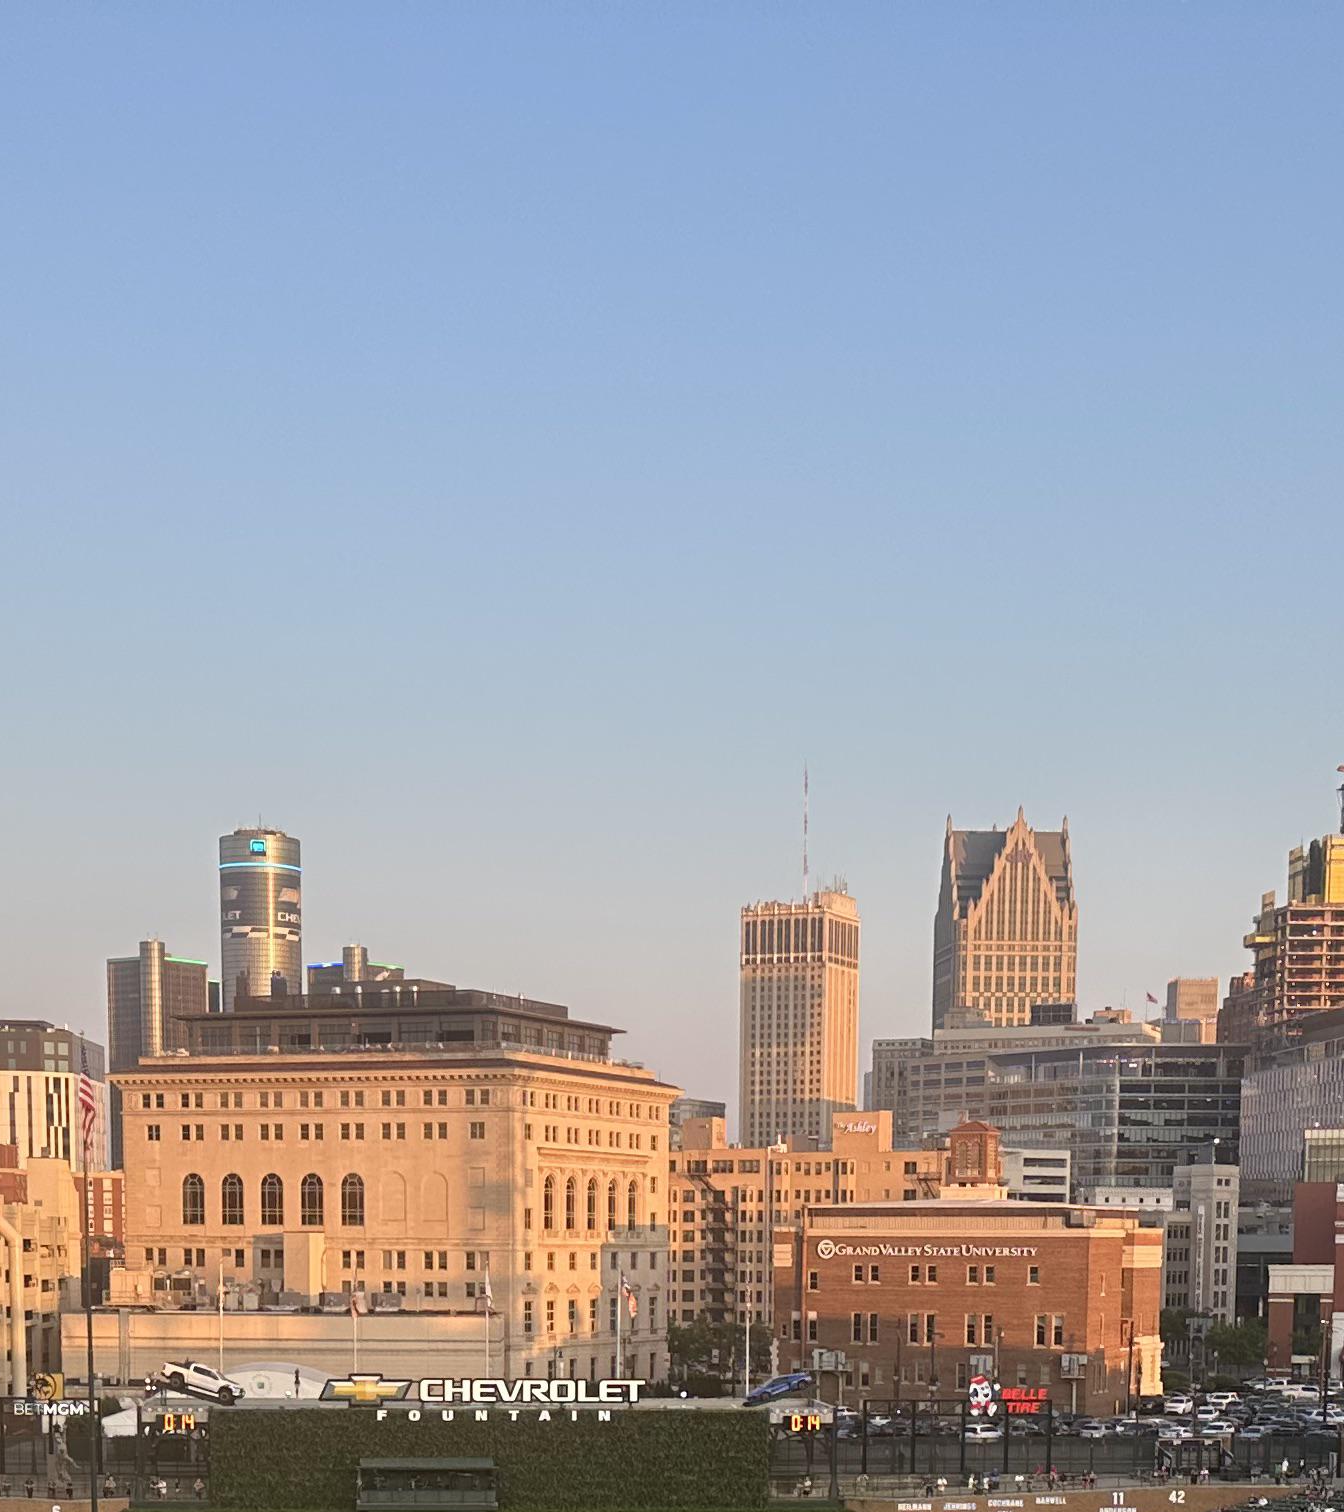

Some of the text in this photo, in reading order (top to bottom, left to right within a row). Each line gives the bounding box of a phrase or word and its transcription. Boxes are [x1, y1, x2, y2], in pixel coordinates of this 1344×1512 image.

[836, 1244, 1037, 1256] GRAND VALLEY STATE UNIVERSITY
[419, 1378, 646, 1404] CHEVROLET
[1001, 1388, 1048, 1399] BELLE
[14, 1402, 84, 1416] BETMGM
[1007, 1402, 1041, 1413] TIRE
[376, 1409, 612, 1422] FOUNTAIN
[790, 1414, 821, 1432] 0:14
[1112, 1492, 1124, 1504] 11
[1168, 1491, 1185, 1504] 42
